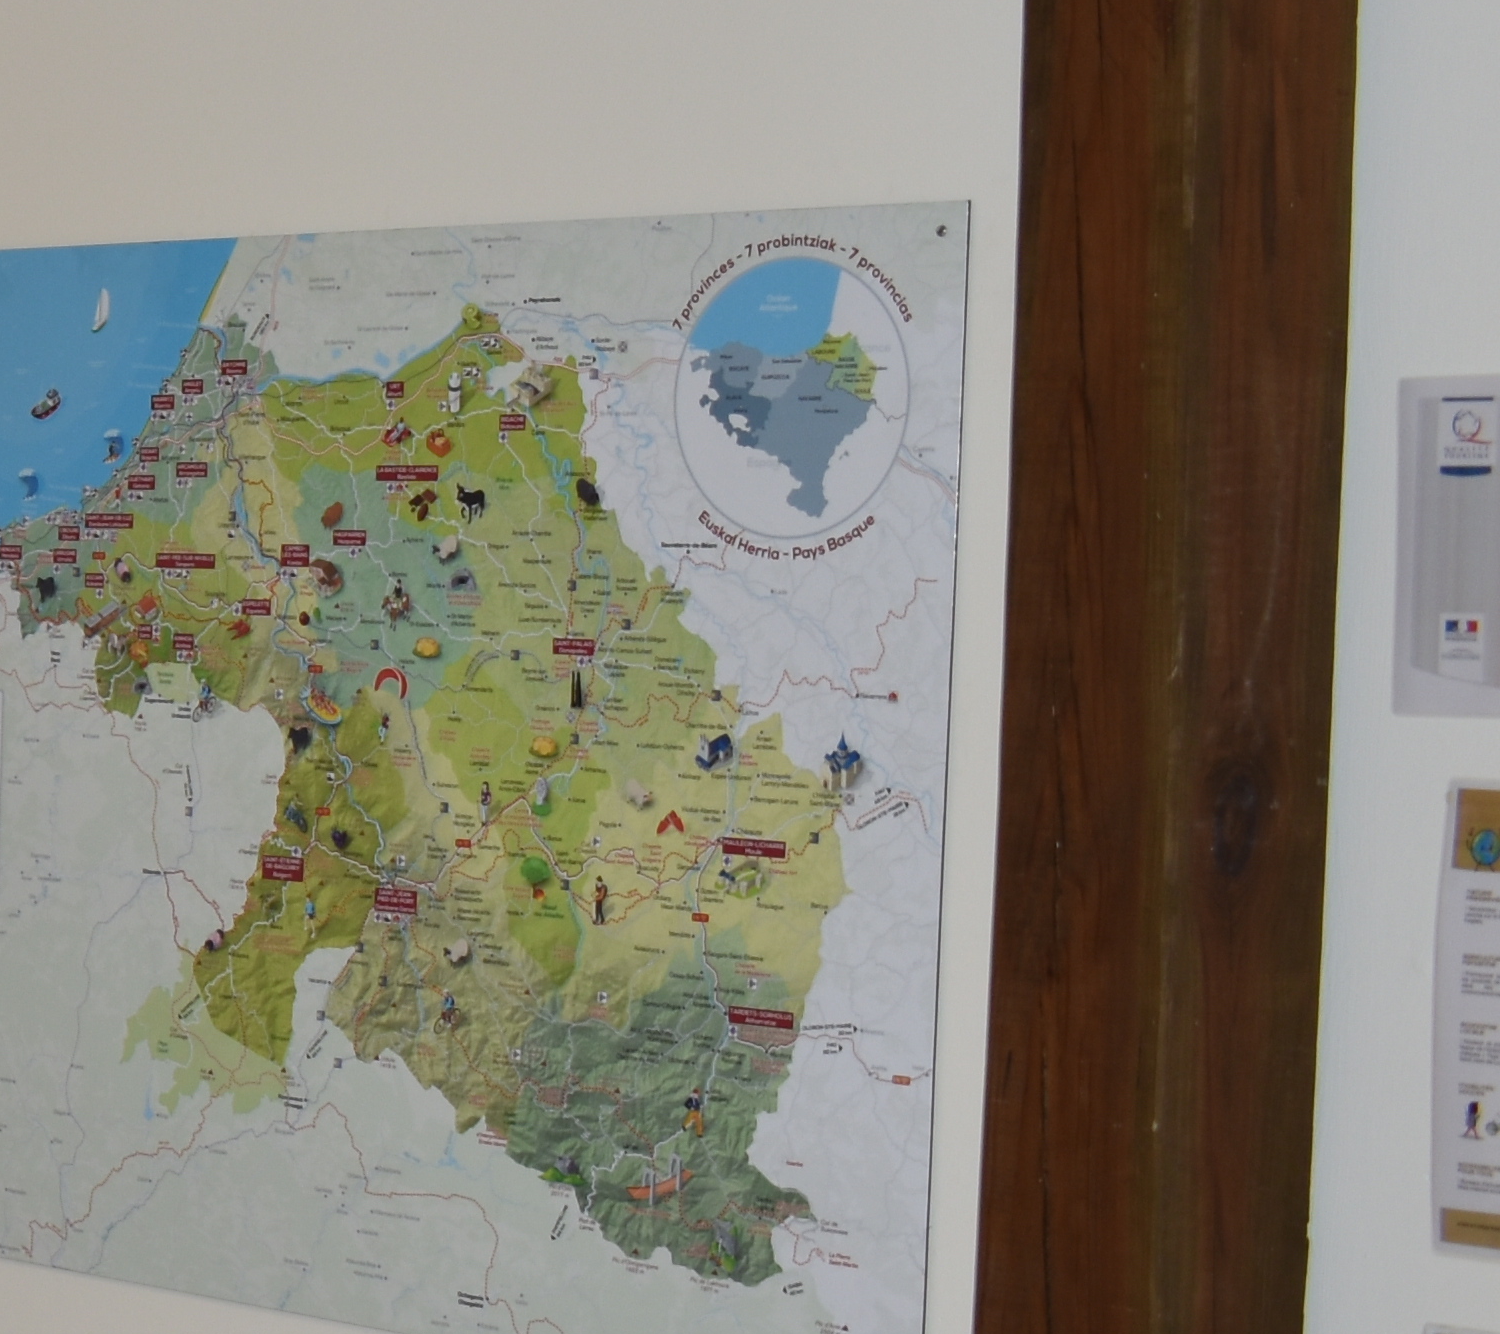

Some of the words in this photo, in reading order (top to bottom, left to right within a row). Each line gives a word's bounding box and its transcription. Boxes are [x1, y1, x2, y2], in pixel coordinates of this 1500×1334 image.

[672, 319, 683, 330] 7
[681, 259, 735, 321] provinces
[745, 244, 754, 257] 7
[757, 234, 837, 256] probintziak
[848, 247, 860, 260] 7
[857, 257, 913, 323] provincias
[698, 510, 737, 547] Euskal
[737, 538, 780, 560] Herria
[792, 546, 825, 560] Pays
[827, 515, 876, 552] Basque
